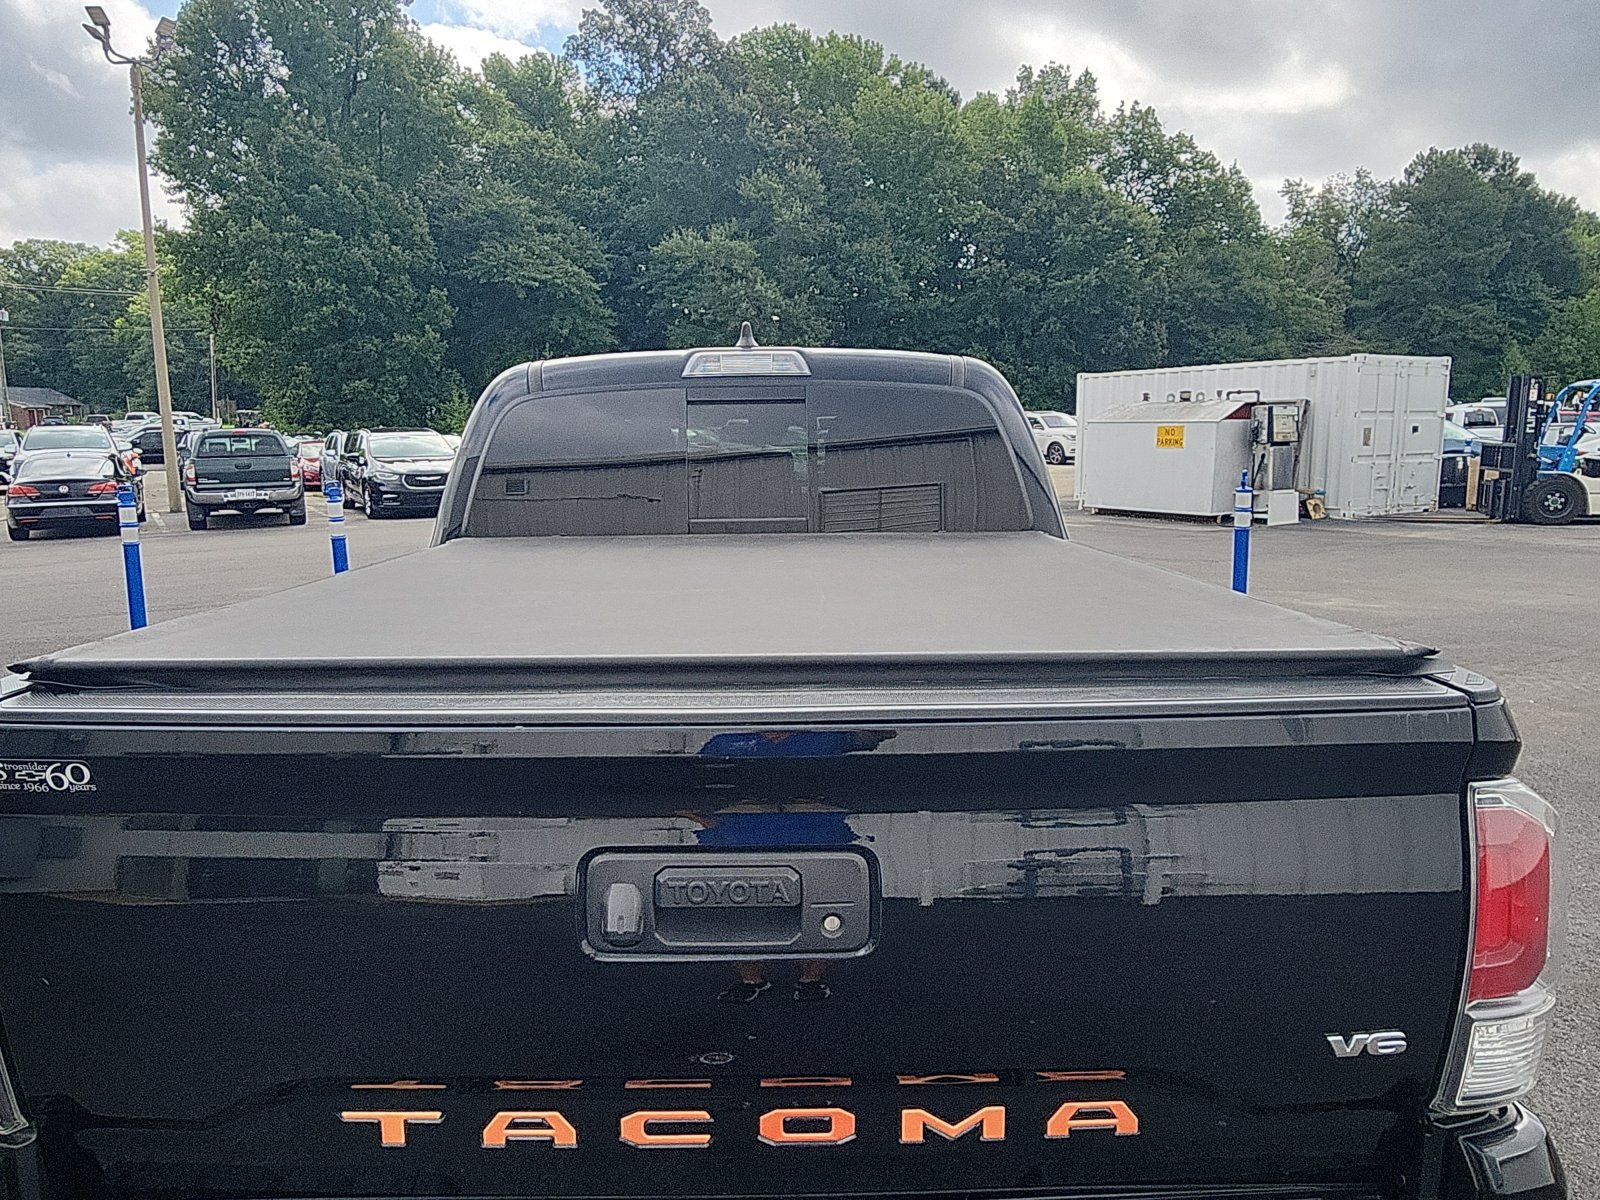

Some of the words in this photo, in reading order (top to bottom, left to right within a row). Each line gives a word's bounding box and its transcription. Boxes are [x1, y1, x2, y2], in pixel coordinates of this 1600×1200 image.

[1164, 428, 1176, 437] NO
[1156, 437, 1184, 447] PARKING
[45, 763, 91, 791] 60
[22, 782, 50, 793] 1966
[68, 783, 97, 793] years
[667, 880, 791, 905] TOYOTA
[1326, 1030, 1408, 1058] V6
[338, 1101, 1141, 1149] TACOMA
